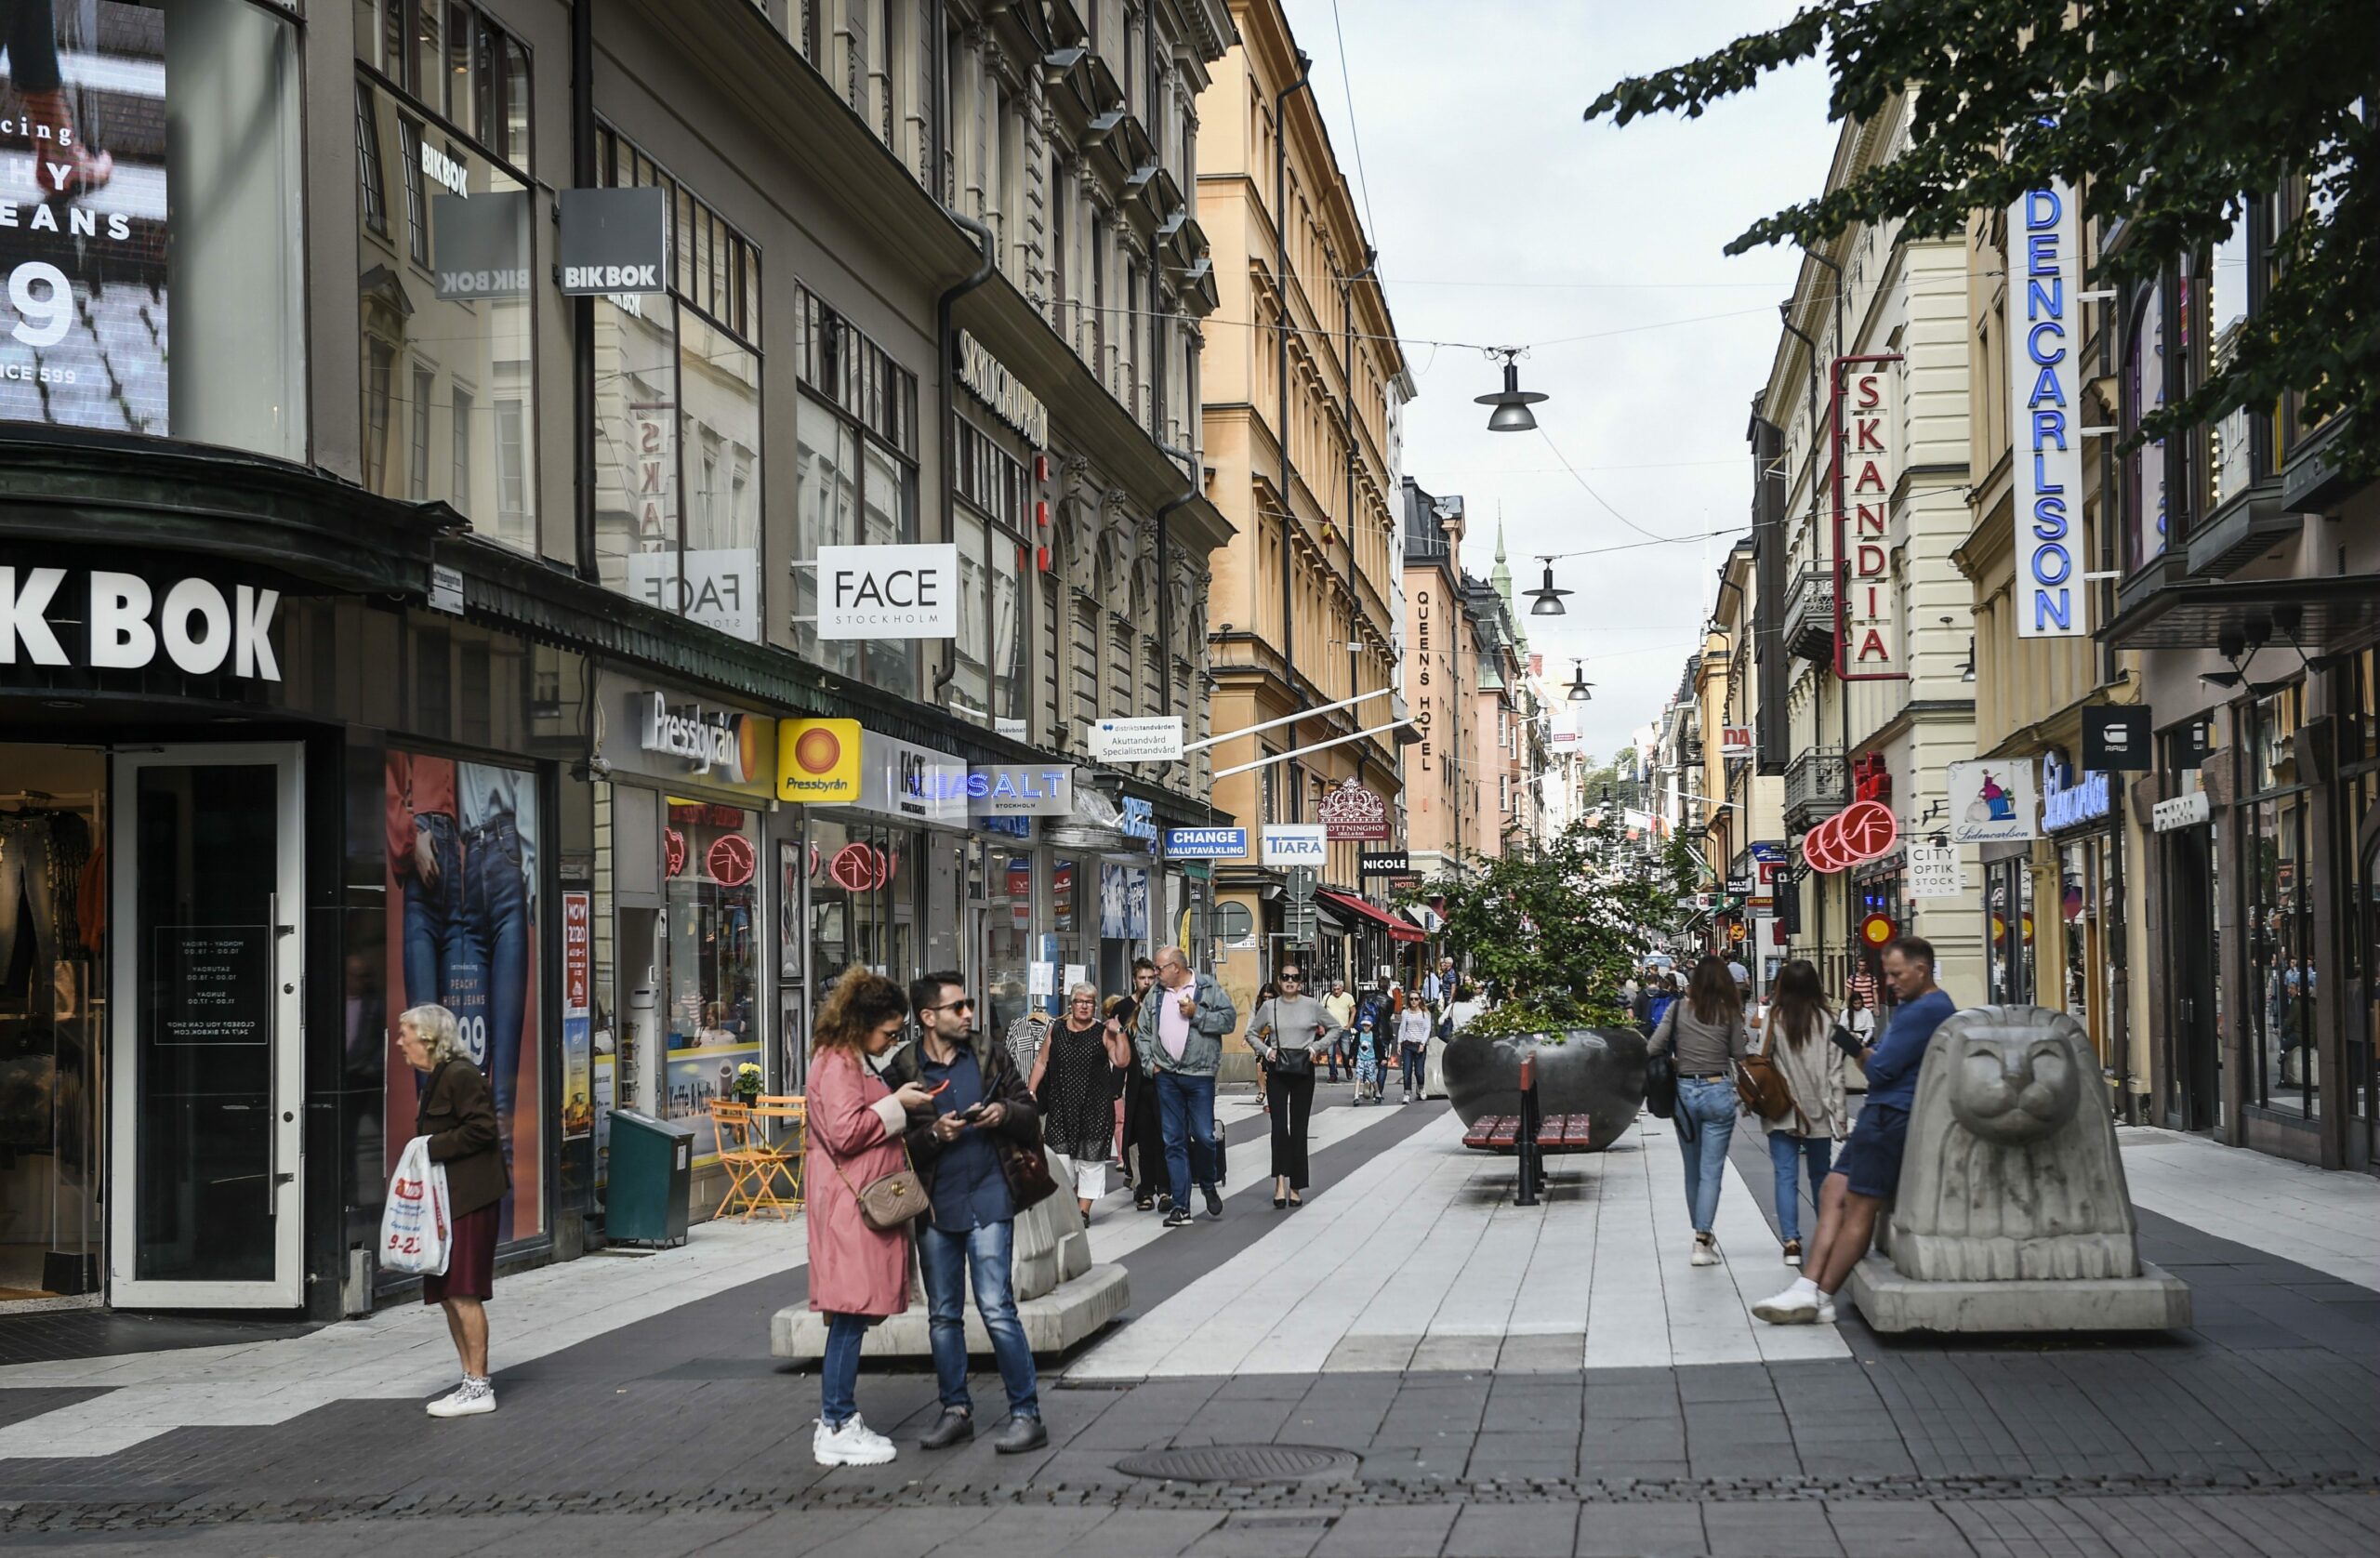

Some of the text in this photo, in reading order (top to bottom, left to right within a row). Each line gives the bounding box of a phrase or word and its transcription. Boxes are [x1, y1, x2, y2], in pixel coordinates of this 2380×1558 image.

[40, 367, 76, 384] 599
[1857, 375, 1891, 660] SKANDIA
[835, 569, 938, 609] FACE
[89, 569, 282, 682] BOK
[835, 614, 939, 625] STOCKHOLM
[648, 691, 734, 775] Pressbyrån
[1115, 723, 1176, 733] distriktstandvården
[1420, 696, 1432, 772] HOTEL
[1111, 735, 1167, 746] Akuttandvård
[1103, 746, 1176, 757] Specialisttandvård
[786, 777, 848, 793] Pressbyrån
[967, 772, 1065, 799] SALT
[1172, 831, 1237, 843] CHANGE
[1167, 845, 1244, 855] VALUTAVÄXLING
[1912, 849, 1954, 861] CITY
[1363, 859, 1407, 869] NICOLE
[1913, 865, 1954, 875] OPTIK
[450, 979, 478, 990] PEACHY
[463, 995, 485, 1006] JEANS
